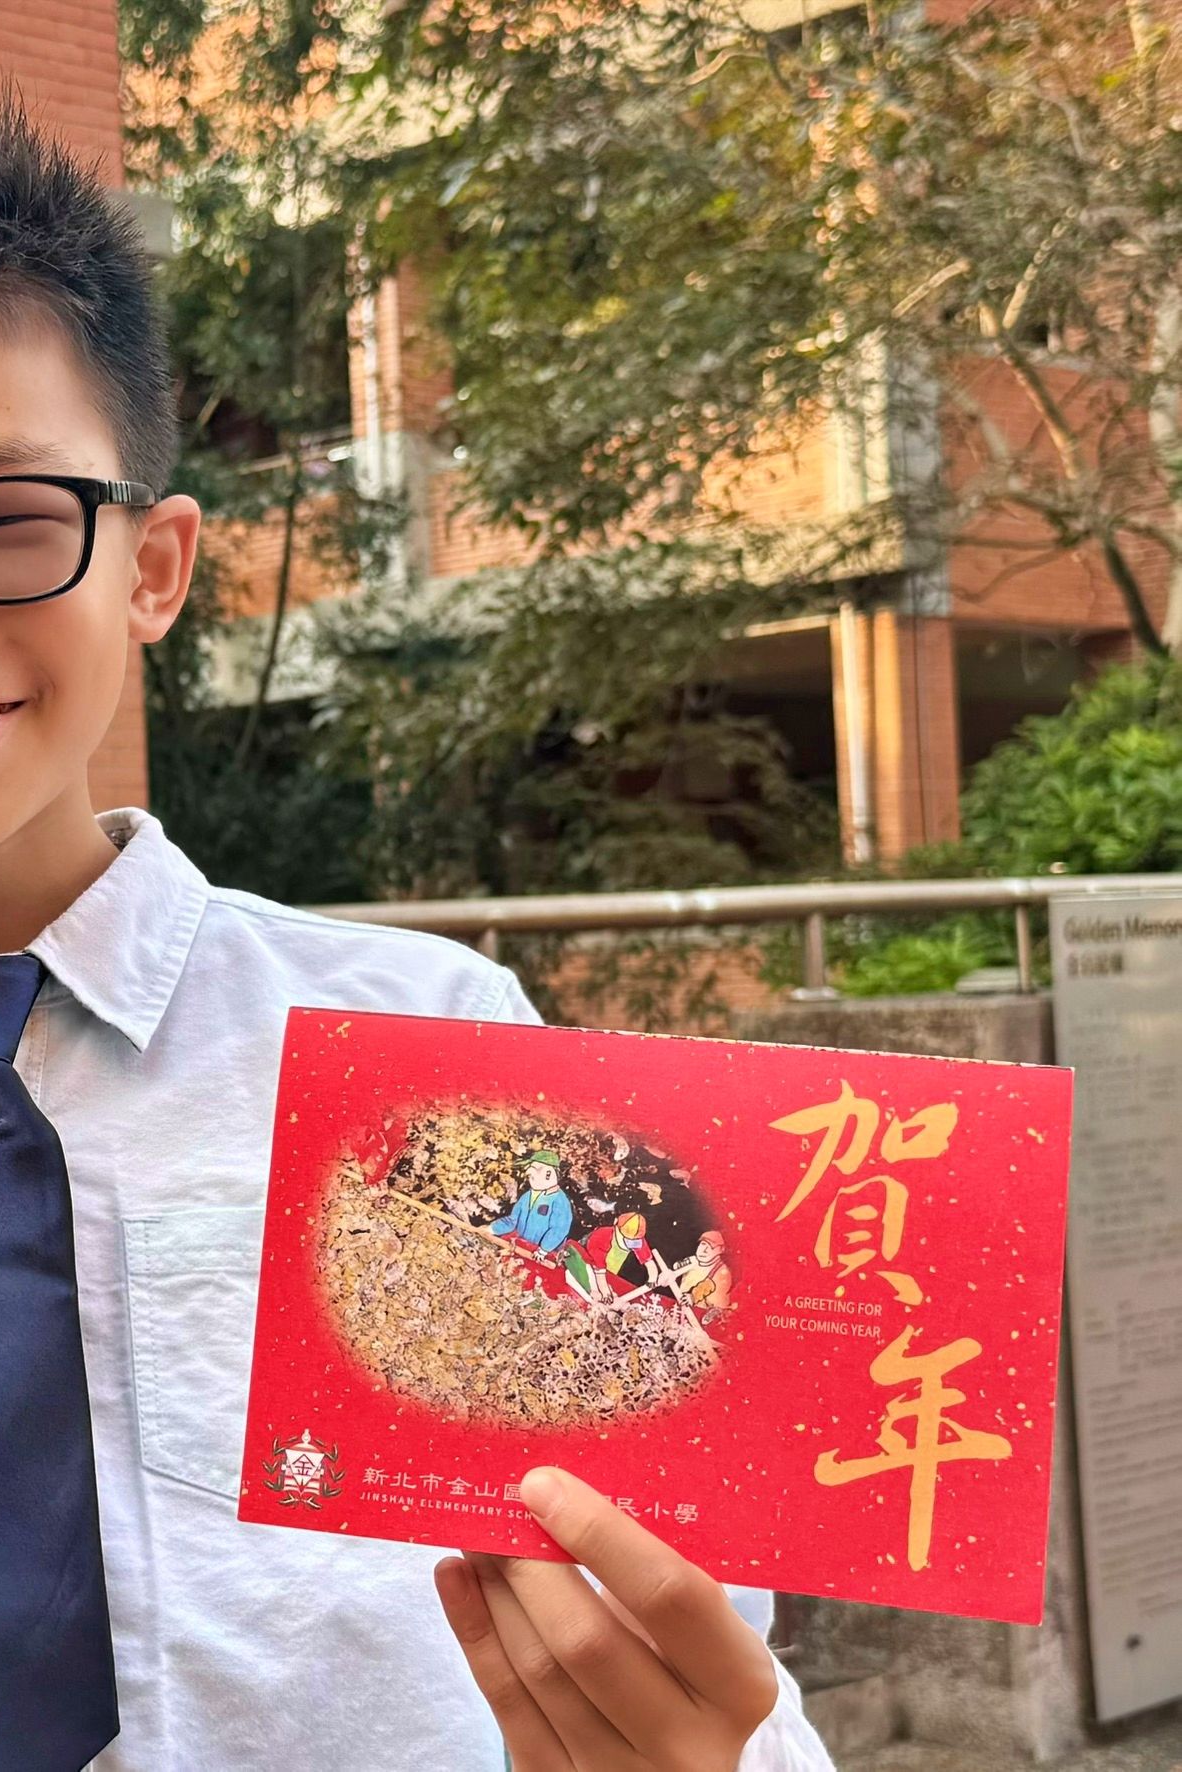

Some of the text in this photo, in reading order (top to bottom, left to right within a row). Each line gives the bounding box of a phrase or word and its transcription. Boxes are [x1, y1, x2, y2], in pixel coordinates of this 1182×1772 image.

[784, 1295, 882, 1316] A GREETING FOR
[764, 1314, 881, 1338] YOUR COMING YEAR
[292, 1453, 315, 1476] 金
[359, 1491, 415, 1506] JINSHAN
[420, 1500, 502, 1517] ELEMENTARY
